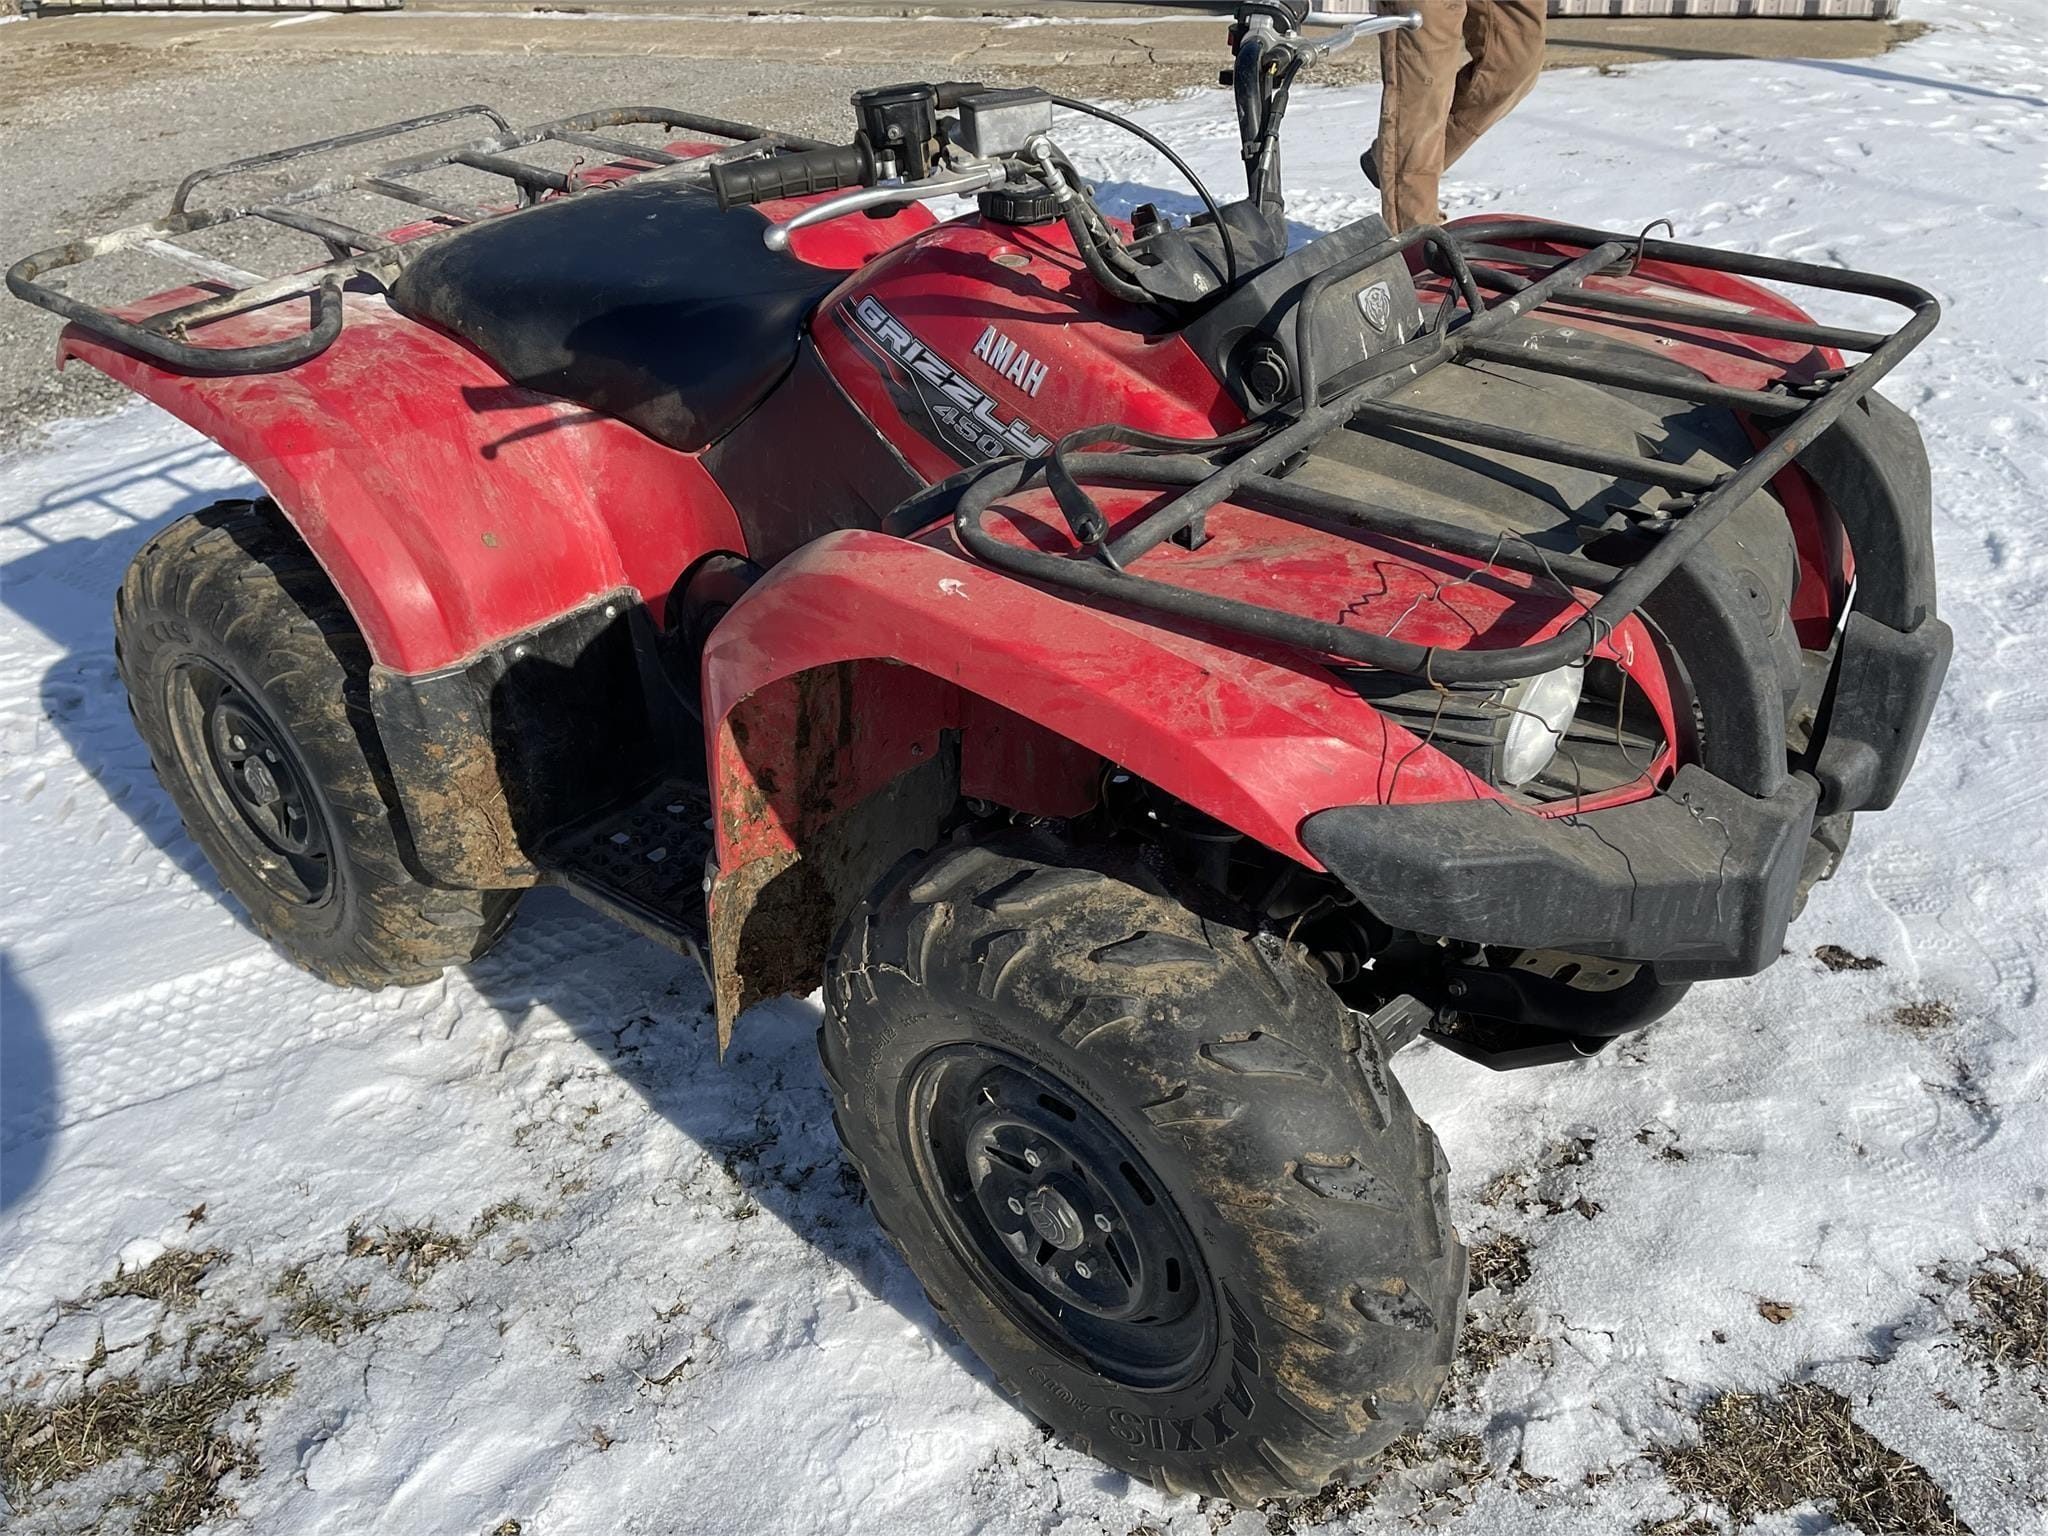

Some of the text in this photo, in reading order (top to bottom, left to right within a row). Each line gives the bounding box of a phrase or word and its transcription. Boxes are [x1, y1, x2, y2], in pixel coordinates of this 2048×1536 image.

[856, 296, 1053, 458] GRIZZLY
[973, 324, 1049, 398] AMAH
[932, 403, 1005, 458] 450
[1104, 1279, 1261, 1451] MAXXIS
